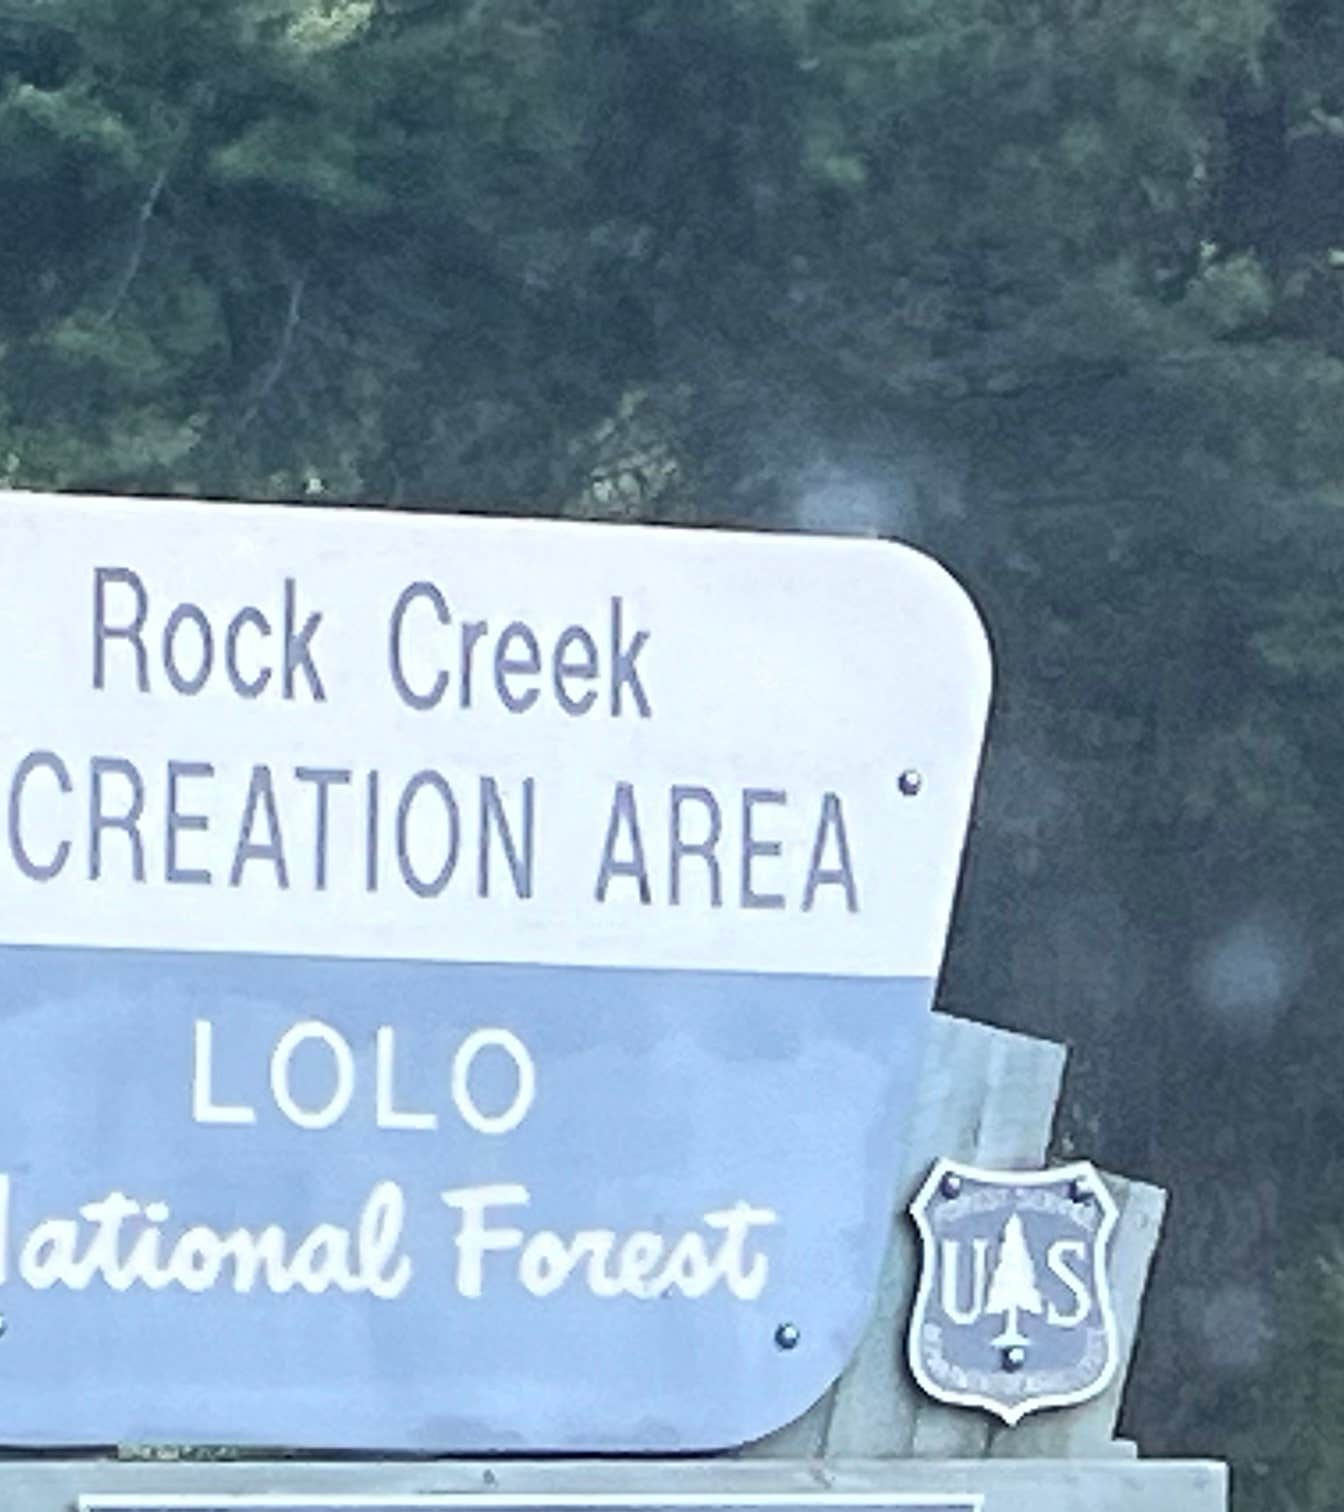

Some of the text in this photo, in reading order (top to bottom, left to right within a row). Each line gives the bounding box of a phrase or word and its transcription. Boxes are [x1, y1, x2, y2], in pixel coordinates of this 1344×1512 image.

[92, 566, 652, 718] Rock Creek
[594, 783, 860, 914] AREA
[190, 1018, 537, 1134] LOLO
[454, 1184, 778, 1298] Forest
